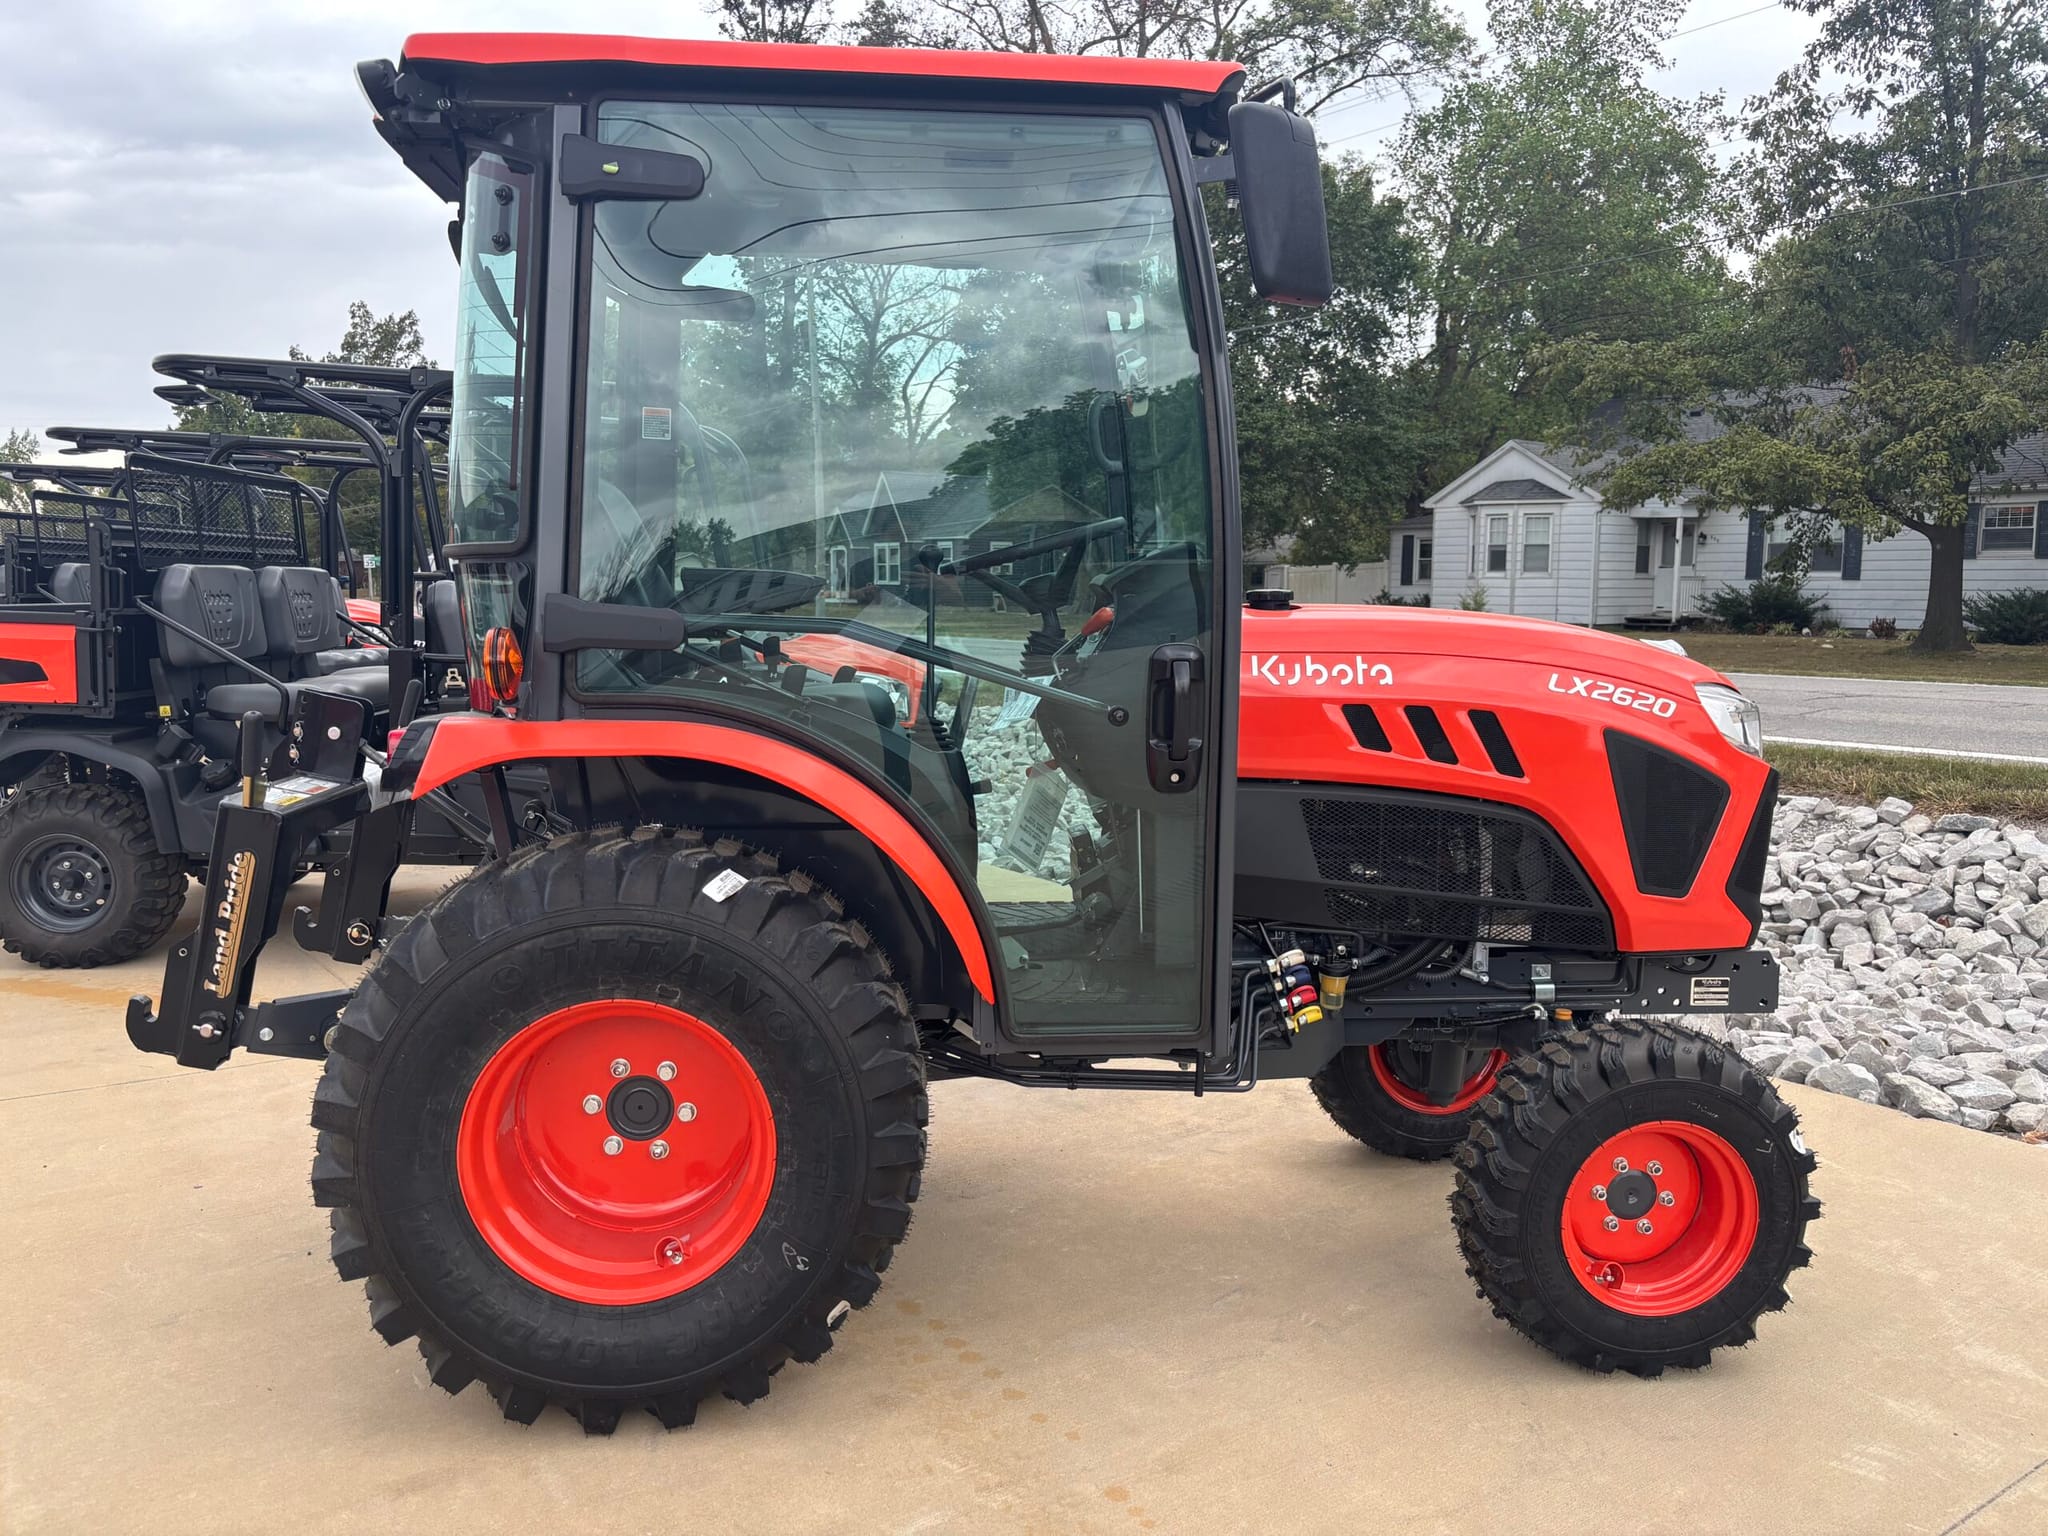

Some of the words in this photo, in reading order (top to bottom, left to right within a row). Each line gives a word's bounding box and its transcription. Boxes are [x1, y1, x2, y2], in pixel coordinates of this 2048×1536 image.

[1251, 655, 1393, 686] Kubota
[1547, 672, 1677, 718] LX2620
[218, 851, 249, 921] Pride
[204, 926, 235, 994] Land
